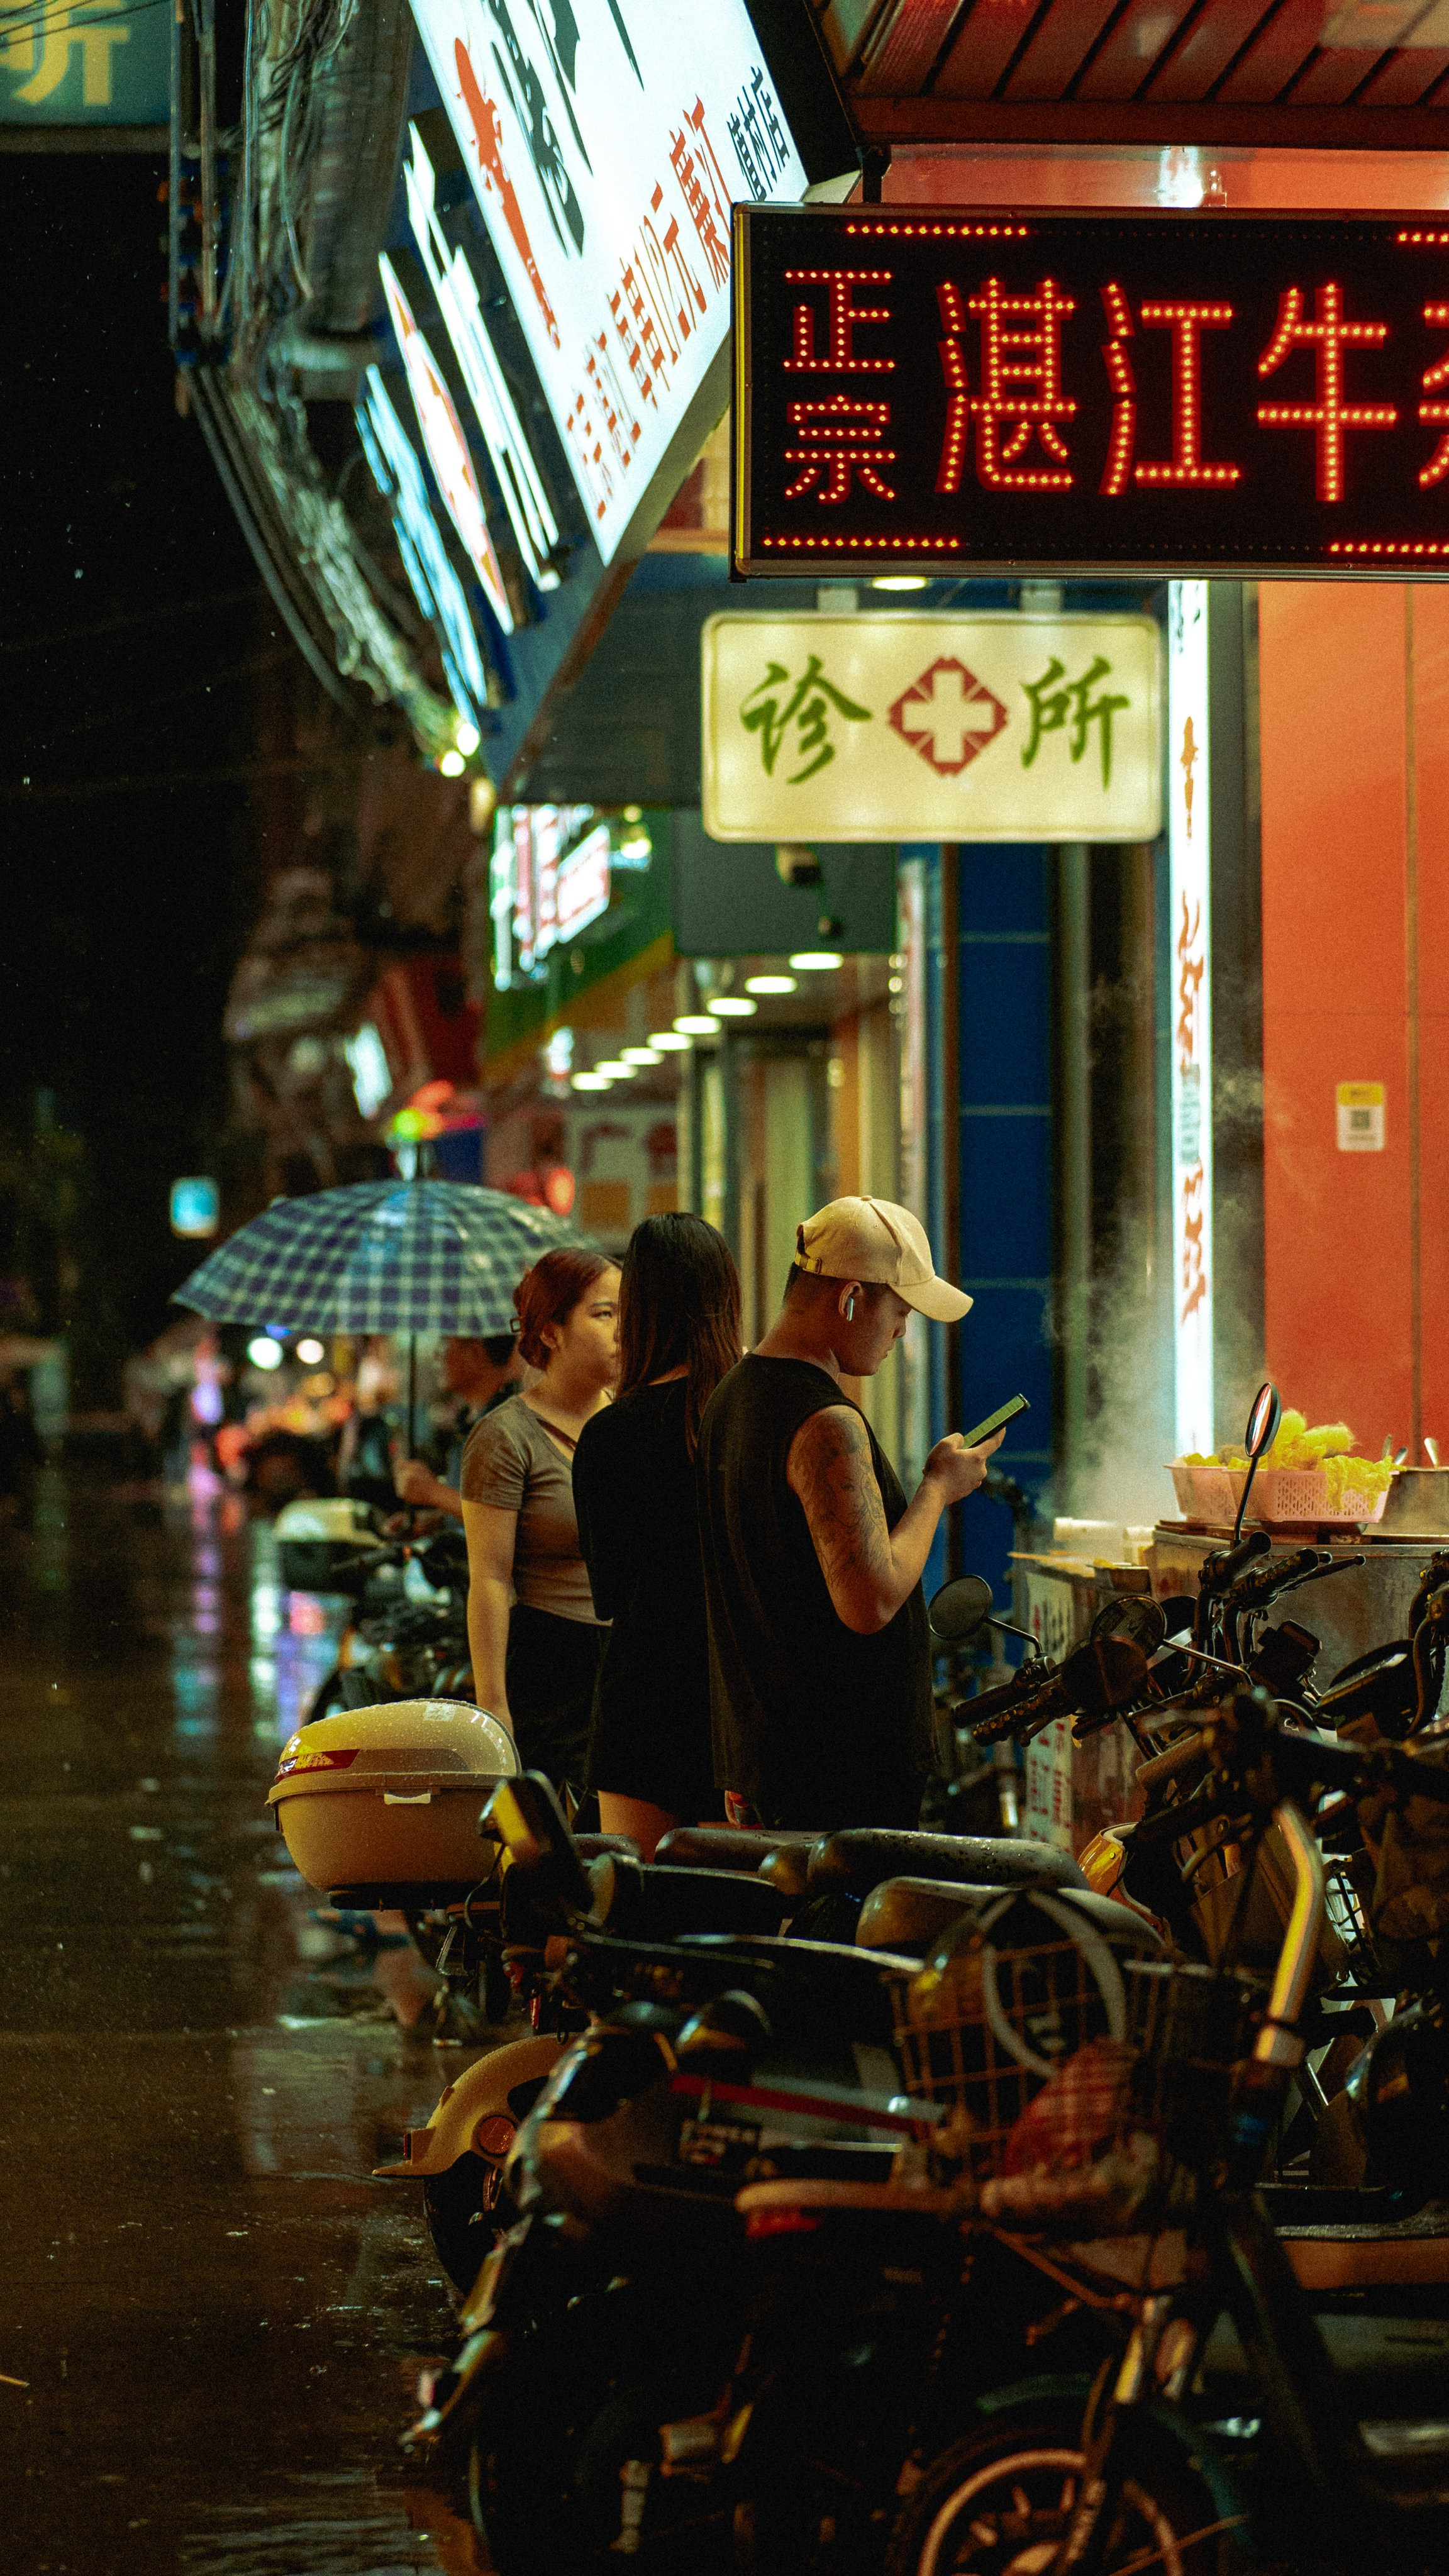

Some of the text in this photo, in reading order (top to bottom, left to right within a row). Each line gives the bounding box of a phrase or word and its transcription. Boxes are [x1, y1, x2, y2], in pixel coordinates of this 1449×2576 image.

[783, 270, 896, 505] 正宗
[934, 276, 1449, 502] 湛江牛
